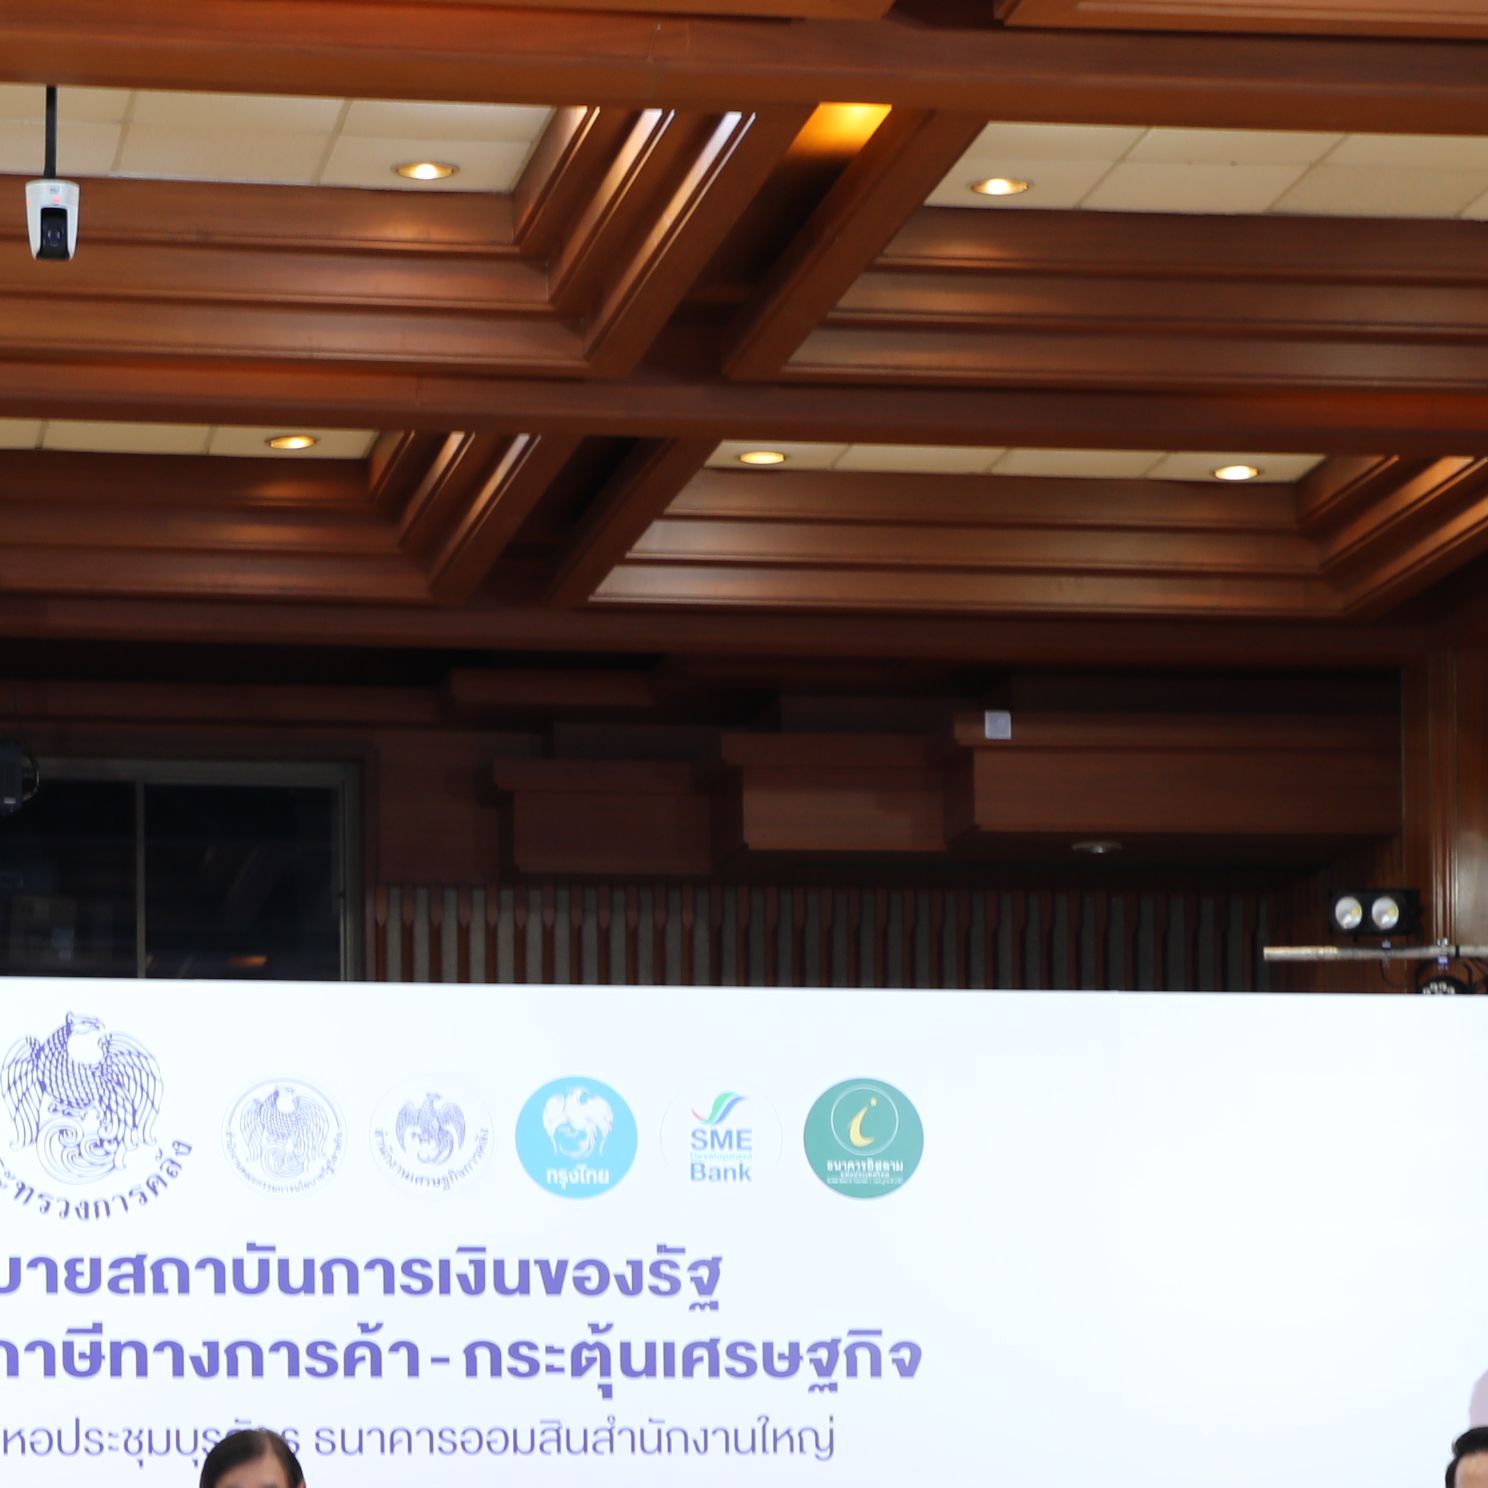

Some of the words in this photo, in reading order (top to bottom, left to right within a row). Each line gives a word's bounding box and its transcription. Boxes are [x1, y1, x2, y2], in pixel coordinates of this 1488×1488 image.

[690, 1128, 753, 1151] SME
[547, 1163, 610, 1190] กรุงไทย
[690, 1162, 753, 1183] Bank
[315, 1415, 835, 1463] ธนาคารออมสินสำนักงานใหญ่
